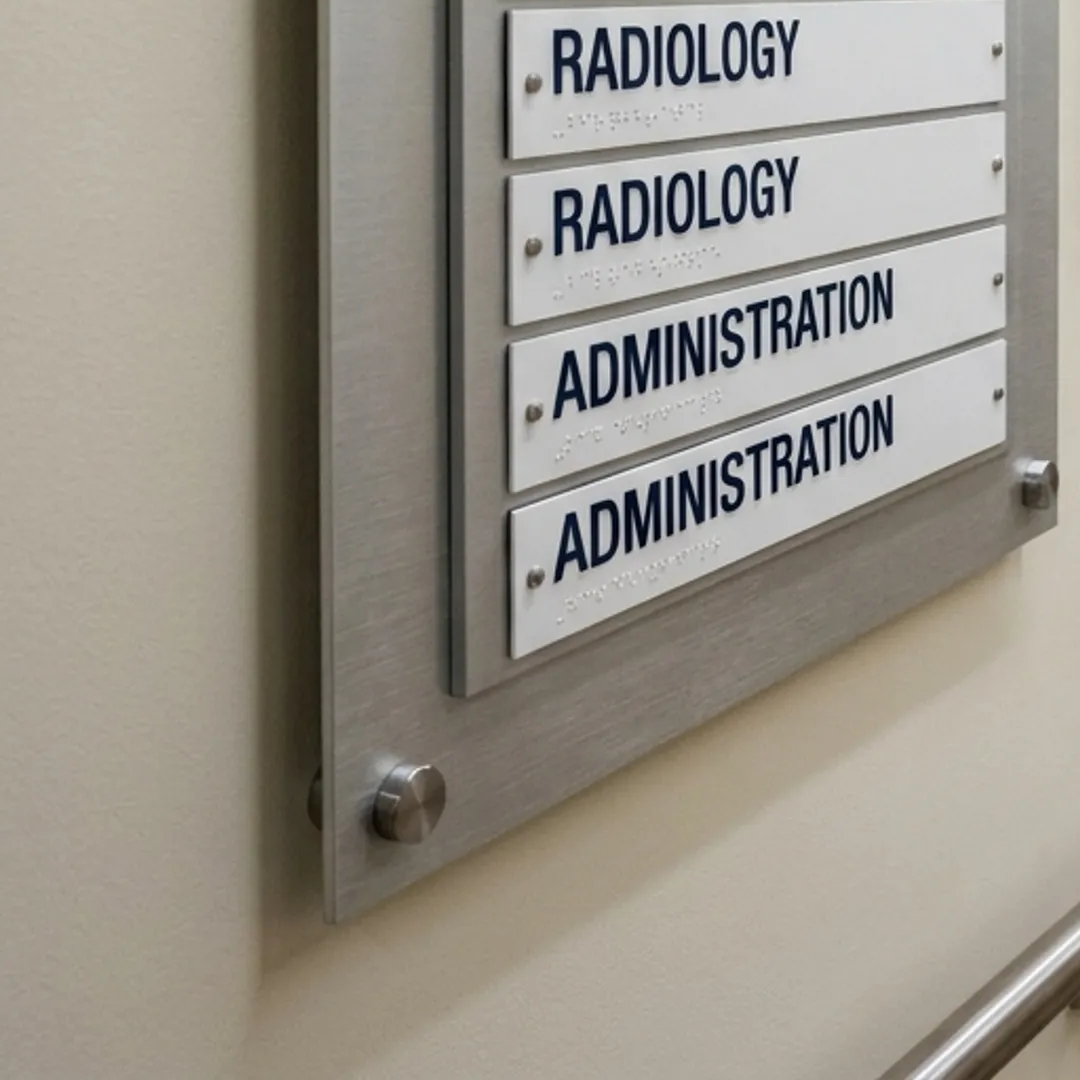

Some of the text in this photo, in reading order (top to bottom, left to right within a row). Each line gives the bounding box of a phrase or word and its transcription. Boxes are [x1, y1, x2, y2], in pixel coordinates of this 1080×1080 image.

[552, 19, 800, 96] RADIOLOGY
[553, 155, 800, 257] RADIOLOGY
[552, 267, 894, 421] ADMINISTRATION
[552, 394, 894, 584] ADMINISTRATION
